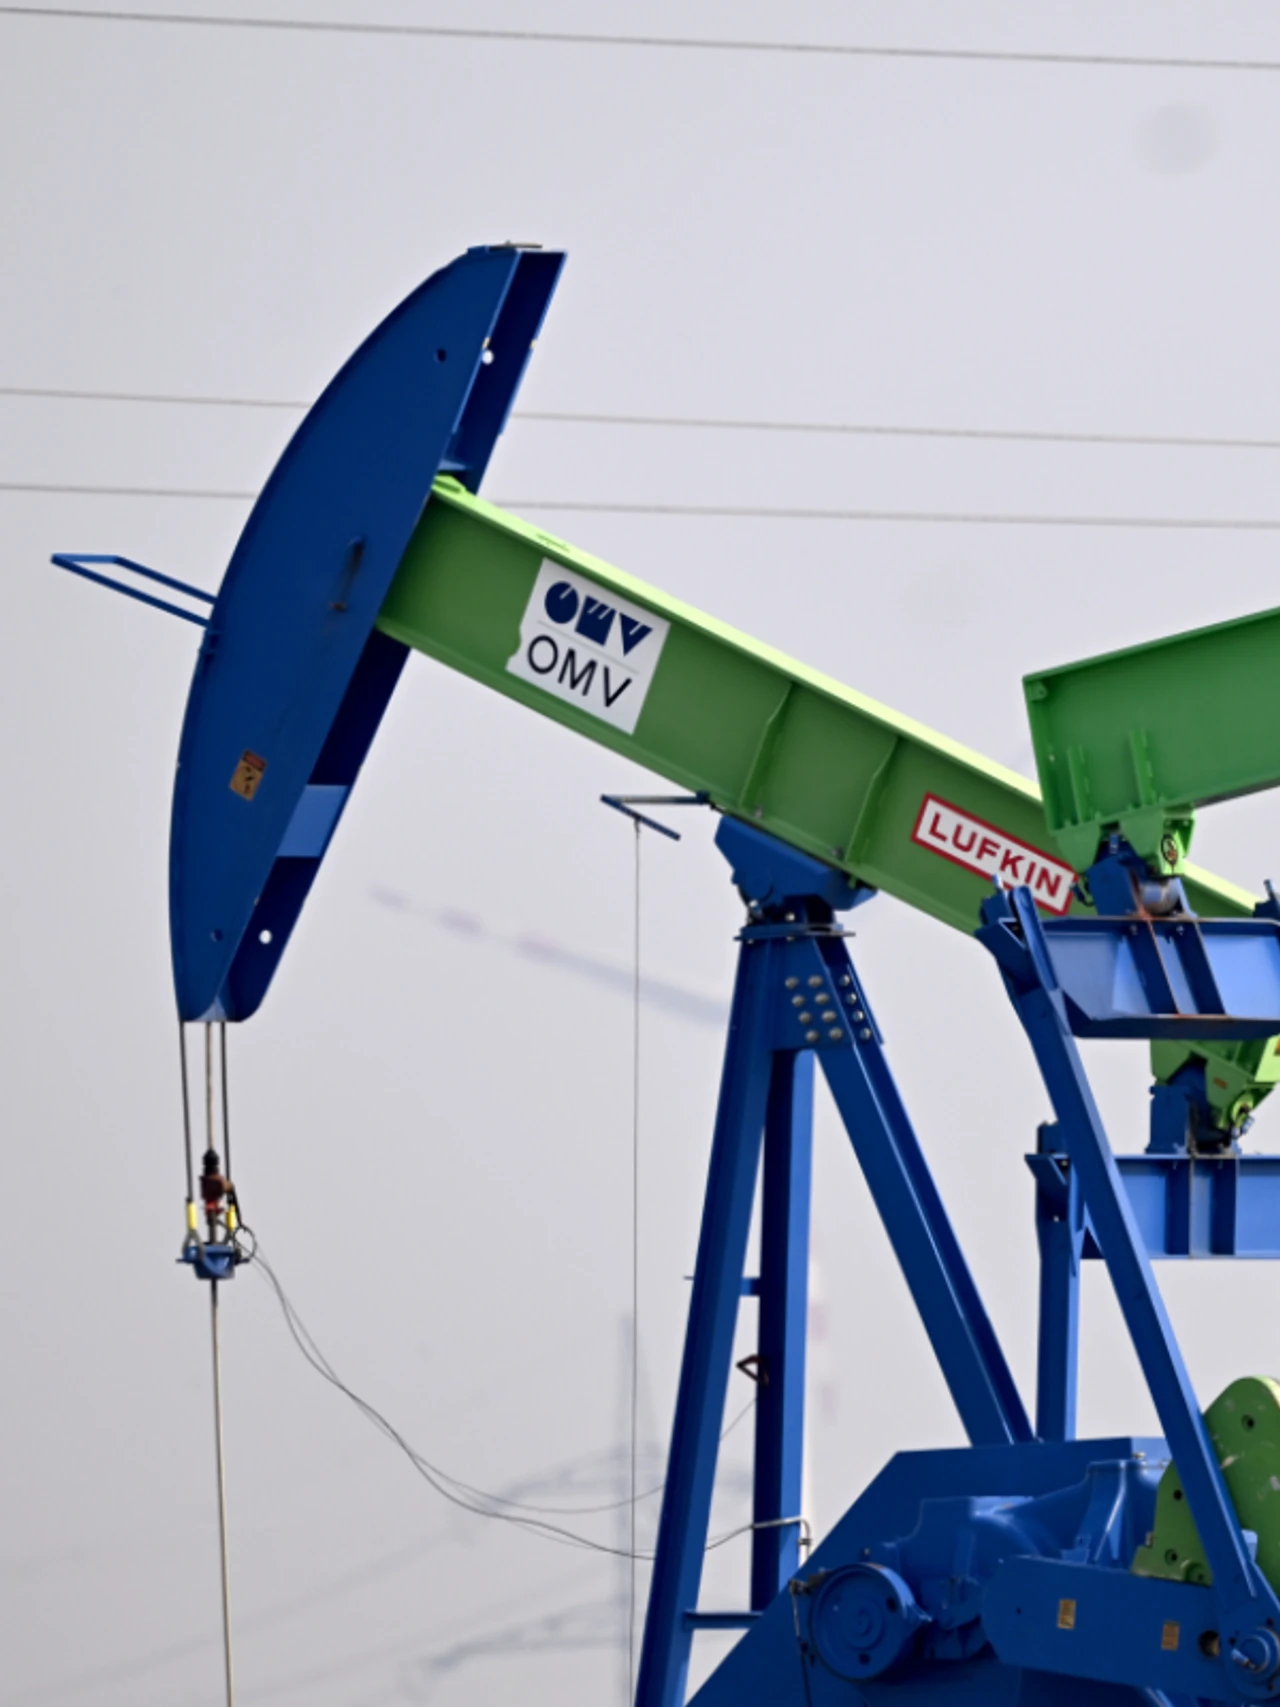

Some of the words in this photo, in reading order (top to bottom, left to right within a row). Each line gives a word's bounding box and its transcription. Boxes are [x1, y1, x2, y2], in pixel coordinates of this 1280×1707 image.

[544, 581, 653, 657] OMV
[527, 635, 632, 708] OMV
[928, 812, 1061, 898] LUFKIN
